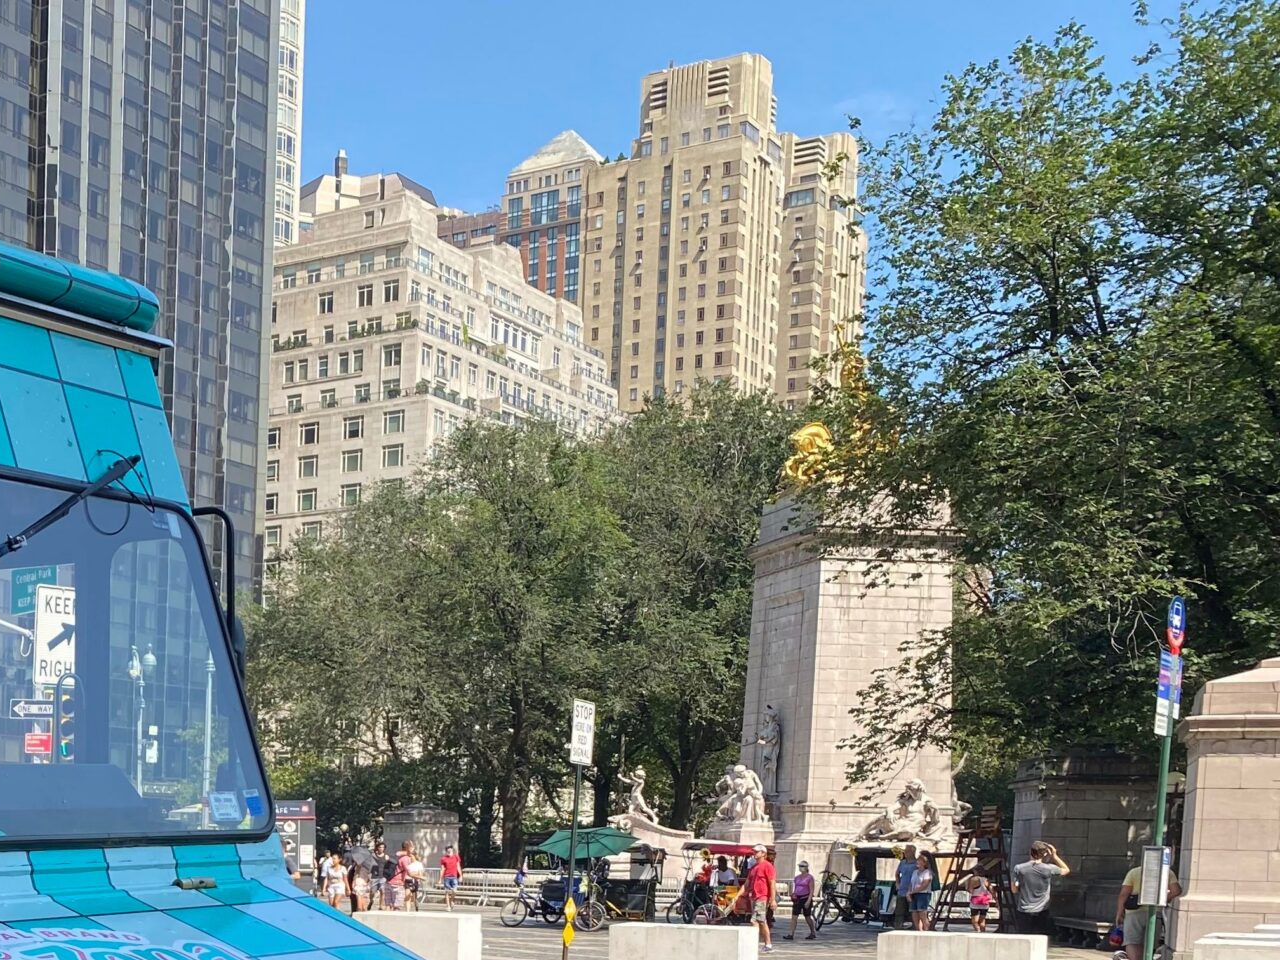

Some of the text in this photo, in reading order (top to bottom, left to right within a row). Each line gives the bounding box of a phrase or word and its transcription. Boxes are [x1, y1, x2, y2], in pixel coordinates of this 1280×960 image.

[16, 567, 52, 584] Central Park
[39, 659, 73, 678] RIGH
[37, 705, 52, 713] WAY
[575, 704, 593, 720] STOP
[578, 735, 588, 745] RED
[573, 747, 590, 759] SIGNAL
[42, 929, 142, 945] BRAND
